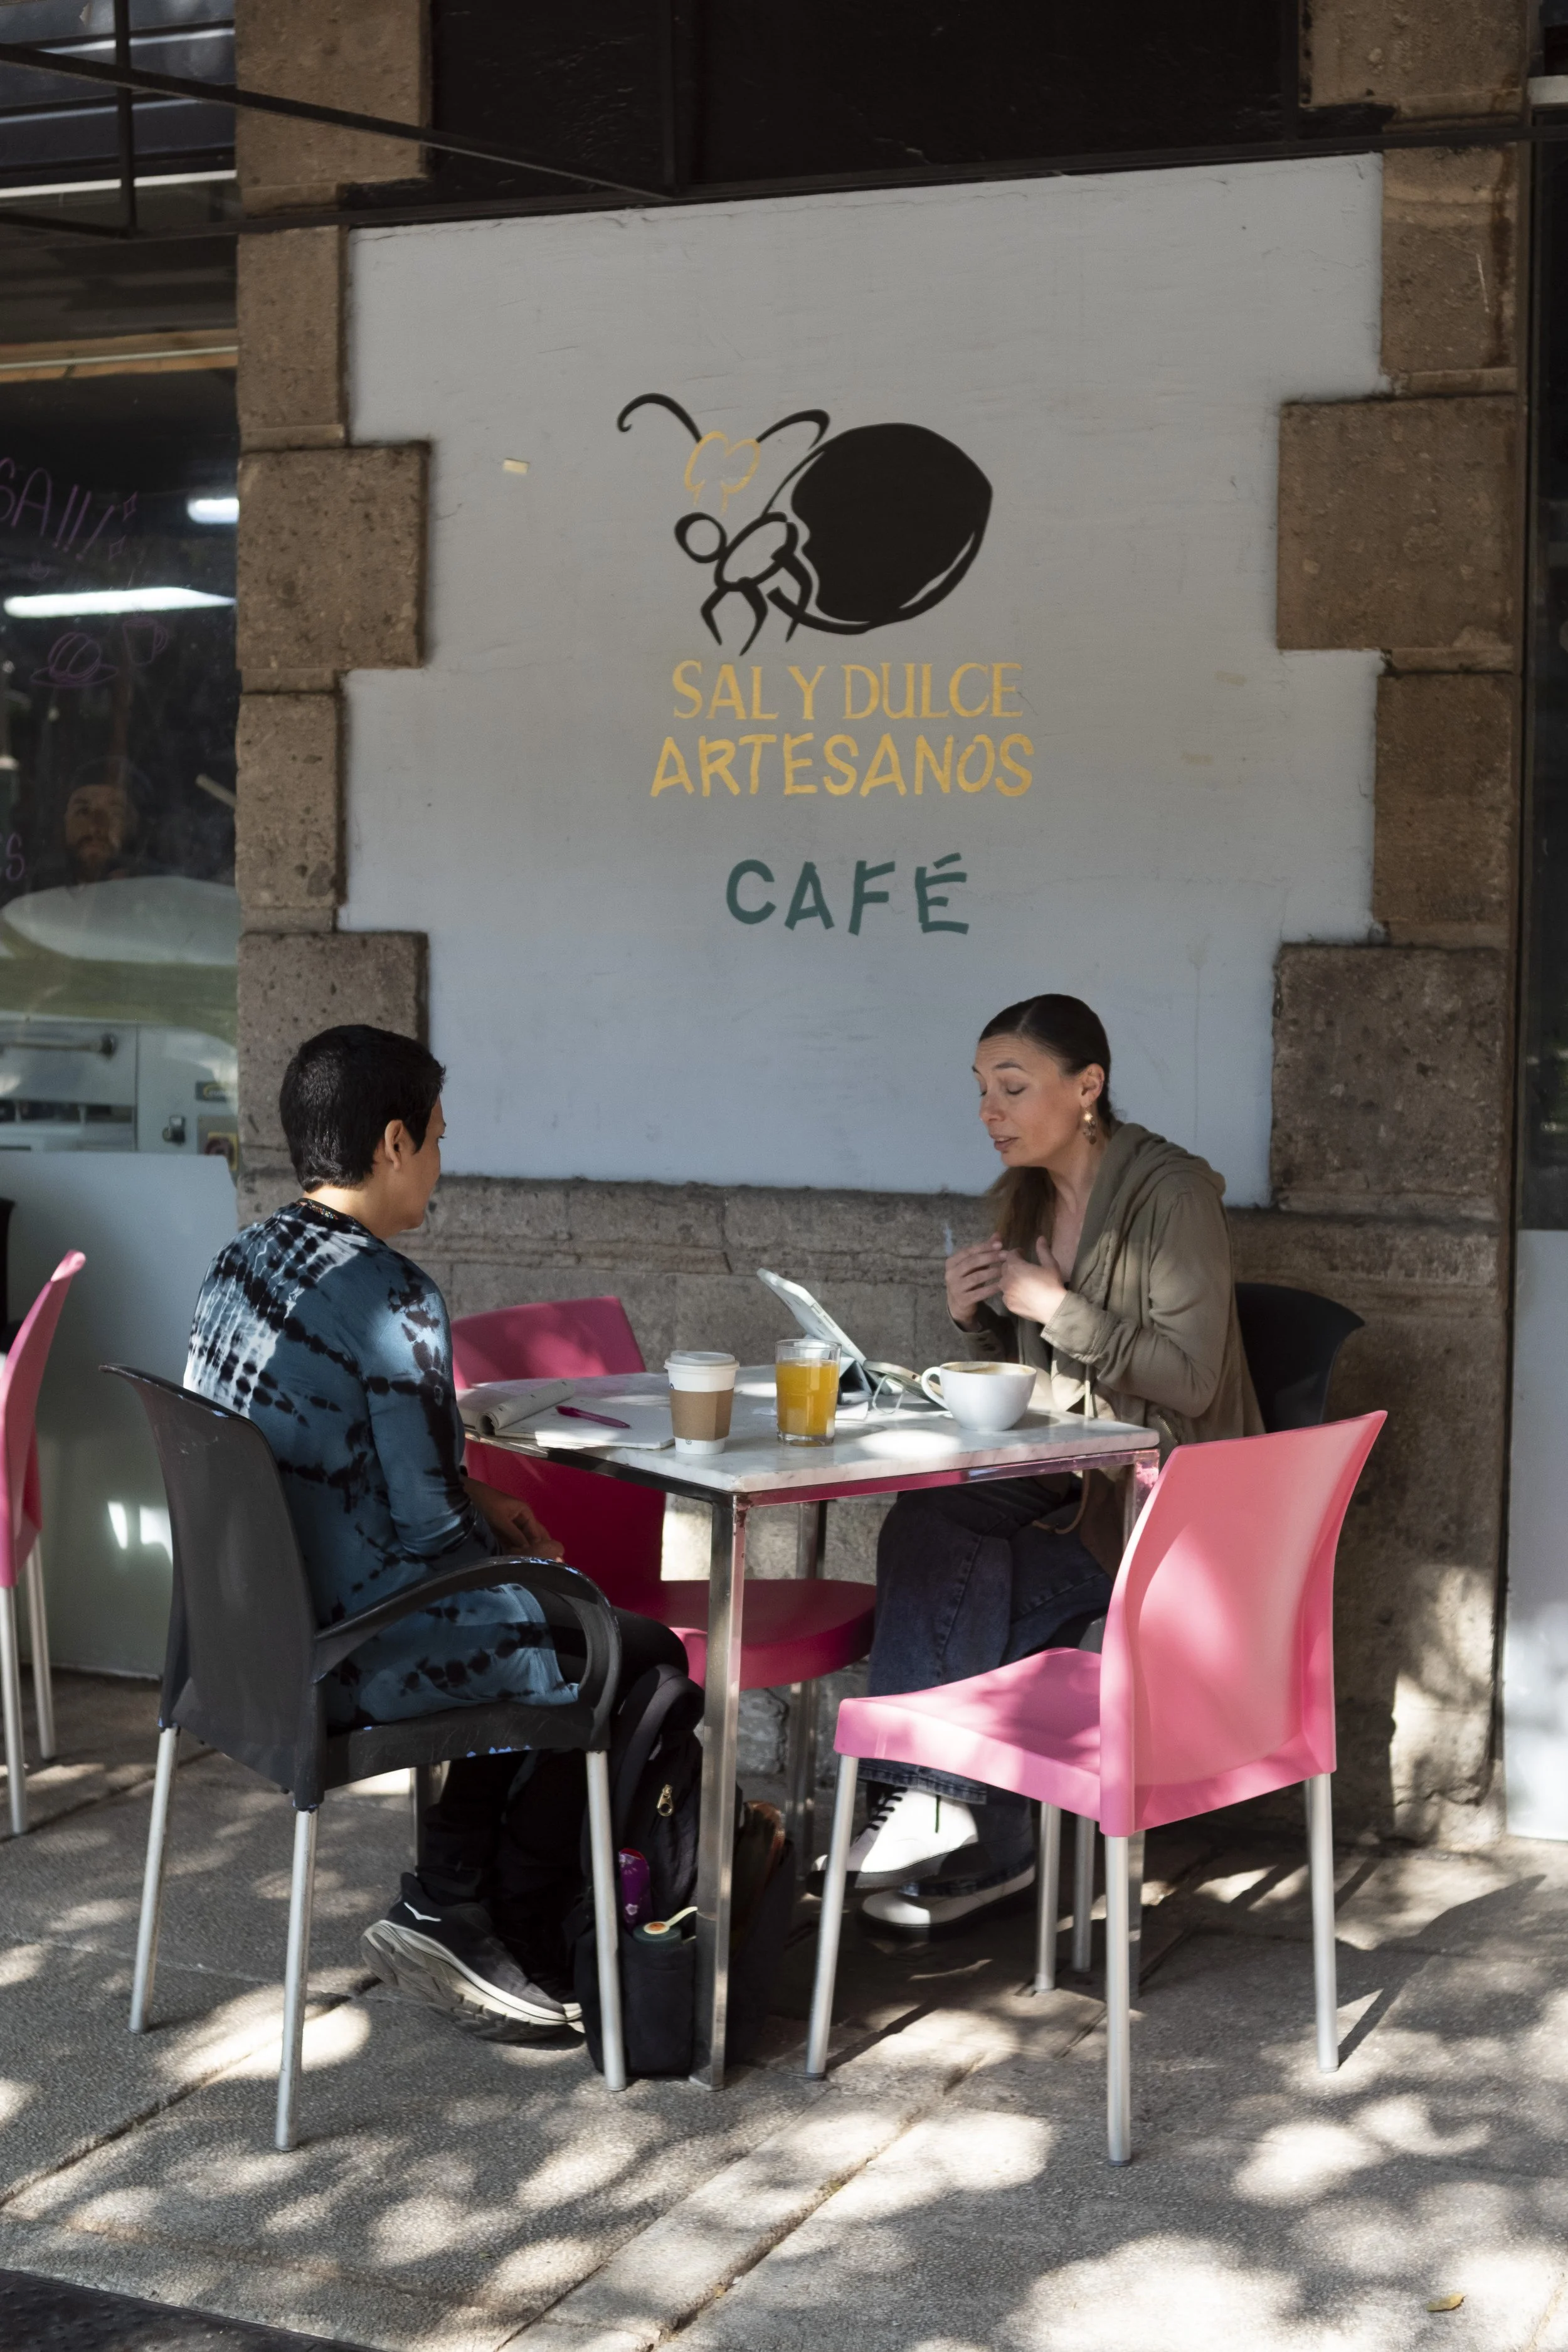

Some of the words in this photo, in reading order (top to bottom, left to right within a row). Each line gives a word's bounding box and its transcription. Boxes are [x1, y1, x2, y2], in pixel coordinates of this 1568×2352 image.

[672, 660, 778, 720] SAL
[788, 665, 825, 720] Y
[842, 662, 1024, 719] DULCE
[650, 733, 1034, 797] ARTESANOS
[726, 852, 969, 936] CAFÉ
